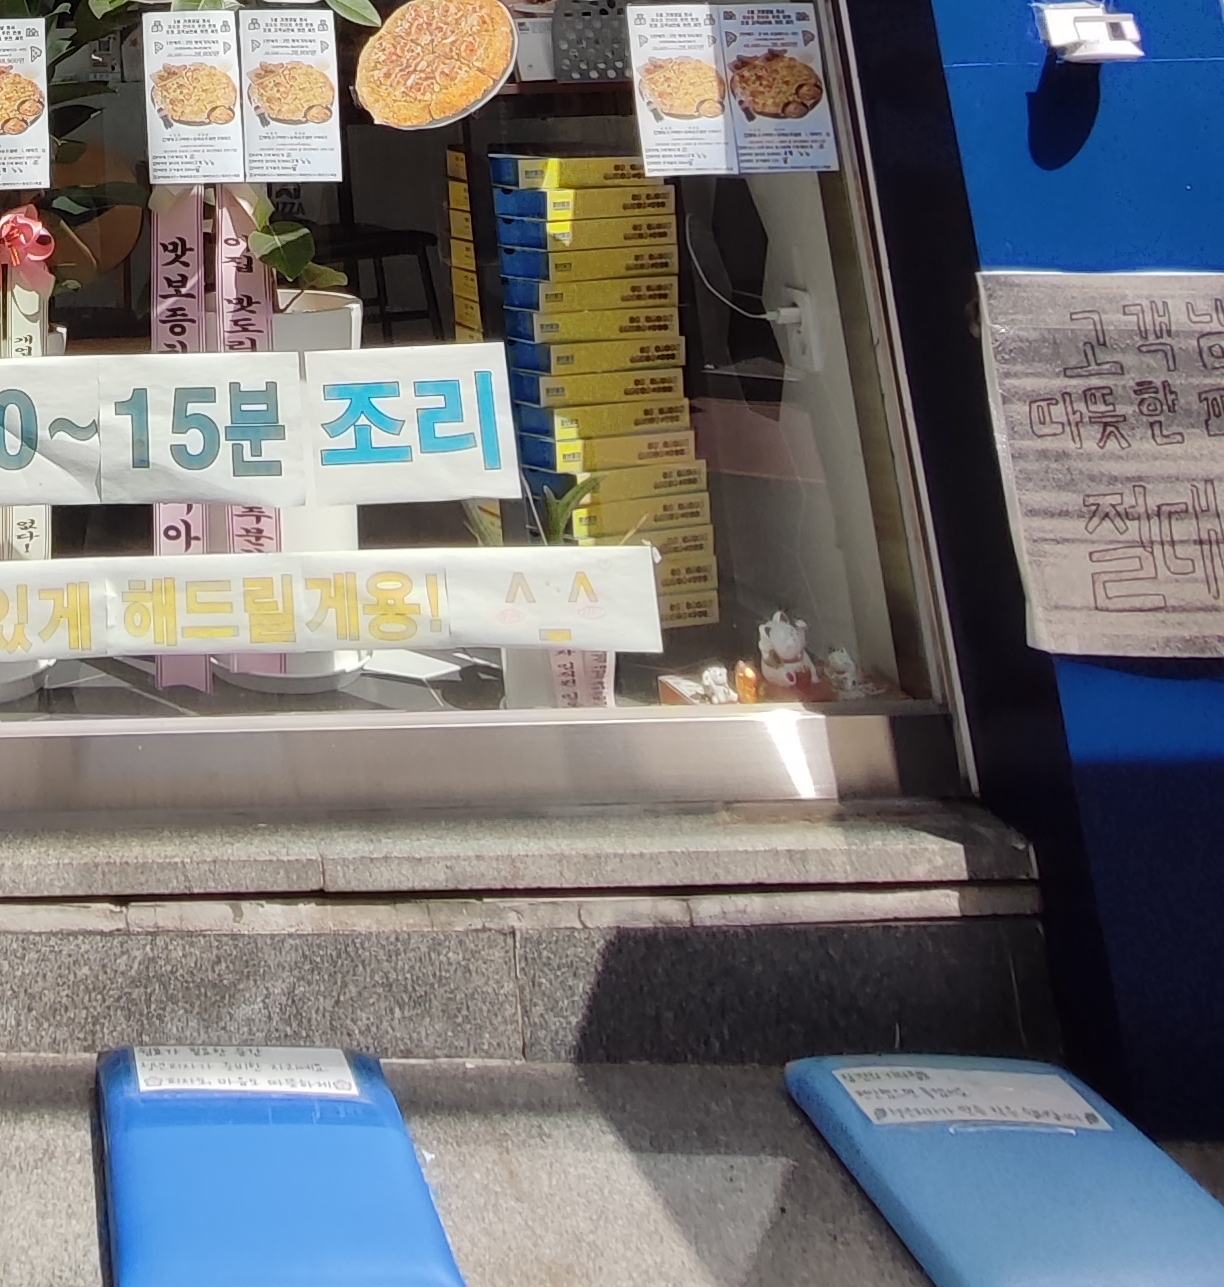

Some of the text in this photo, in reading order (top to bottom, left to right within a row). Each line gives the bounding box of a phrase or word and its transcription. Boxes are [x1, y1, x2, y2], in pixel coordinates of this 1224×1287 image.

[321, 371, 502, 471] 조리
[1029, 380, 1185, 450] 따뜻한
[121, 572, 442, 647] 해드릴게용!
